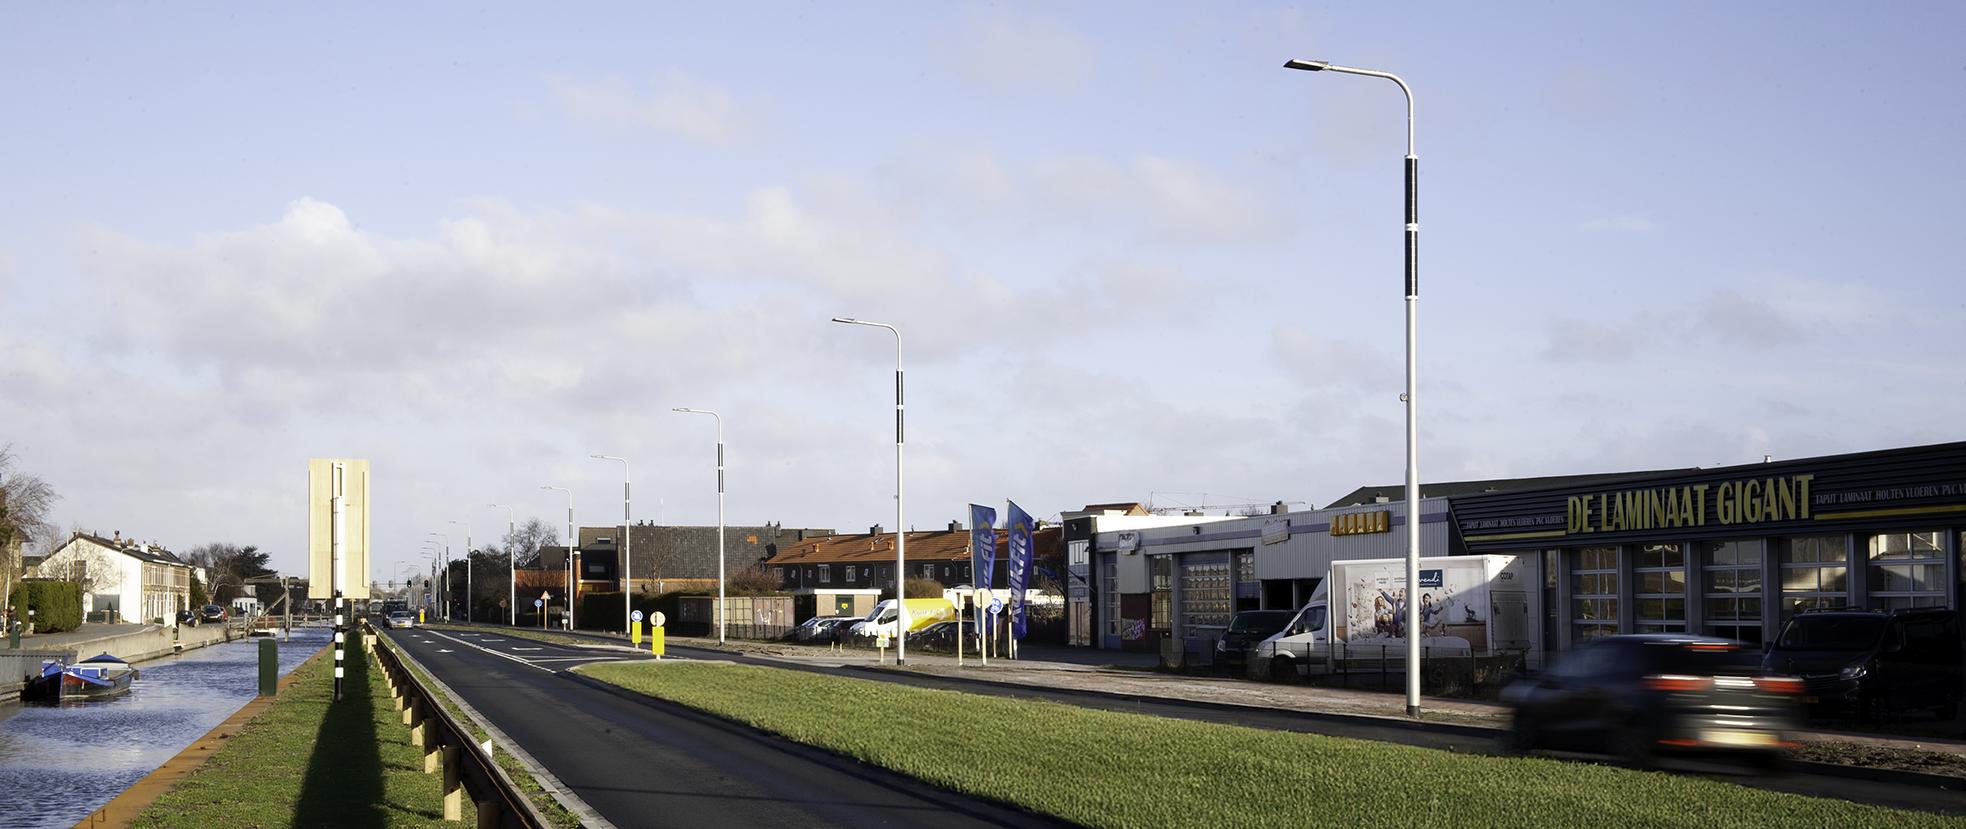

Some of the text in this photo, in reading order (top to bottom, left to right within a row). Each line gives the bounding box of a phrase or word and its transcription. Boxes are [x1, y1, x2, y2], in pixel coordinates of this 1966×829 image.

[1567, 474, 1815, 534] DE LAMINAAT GIGANT
